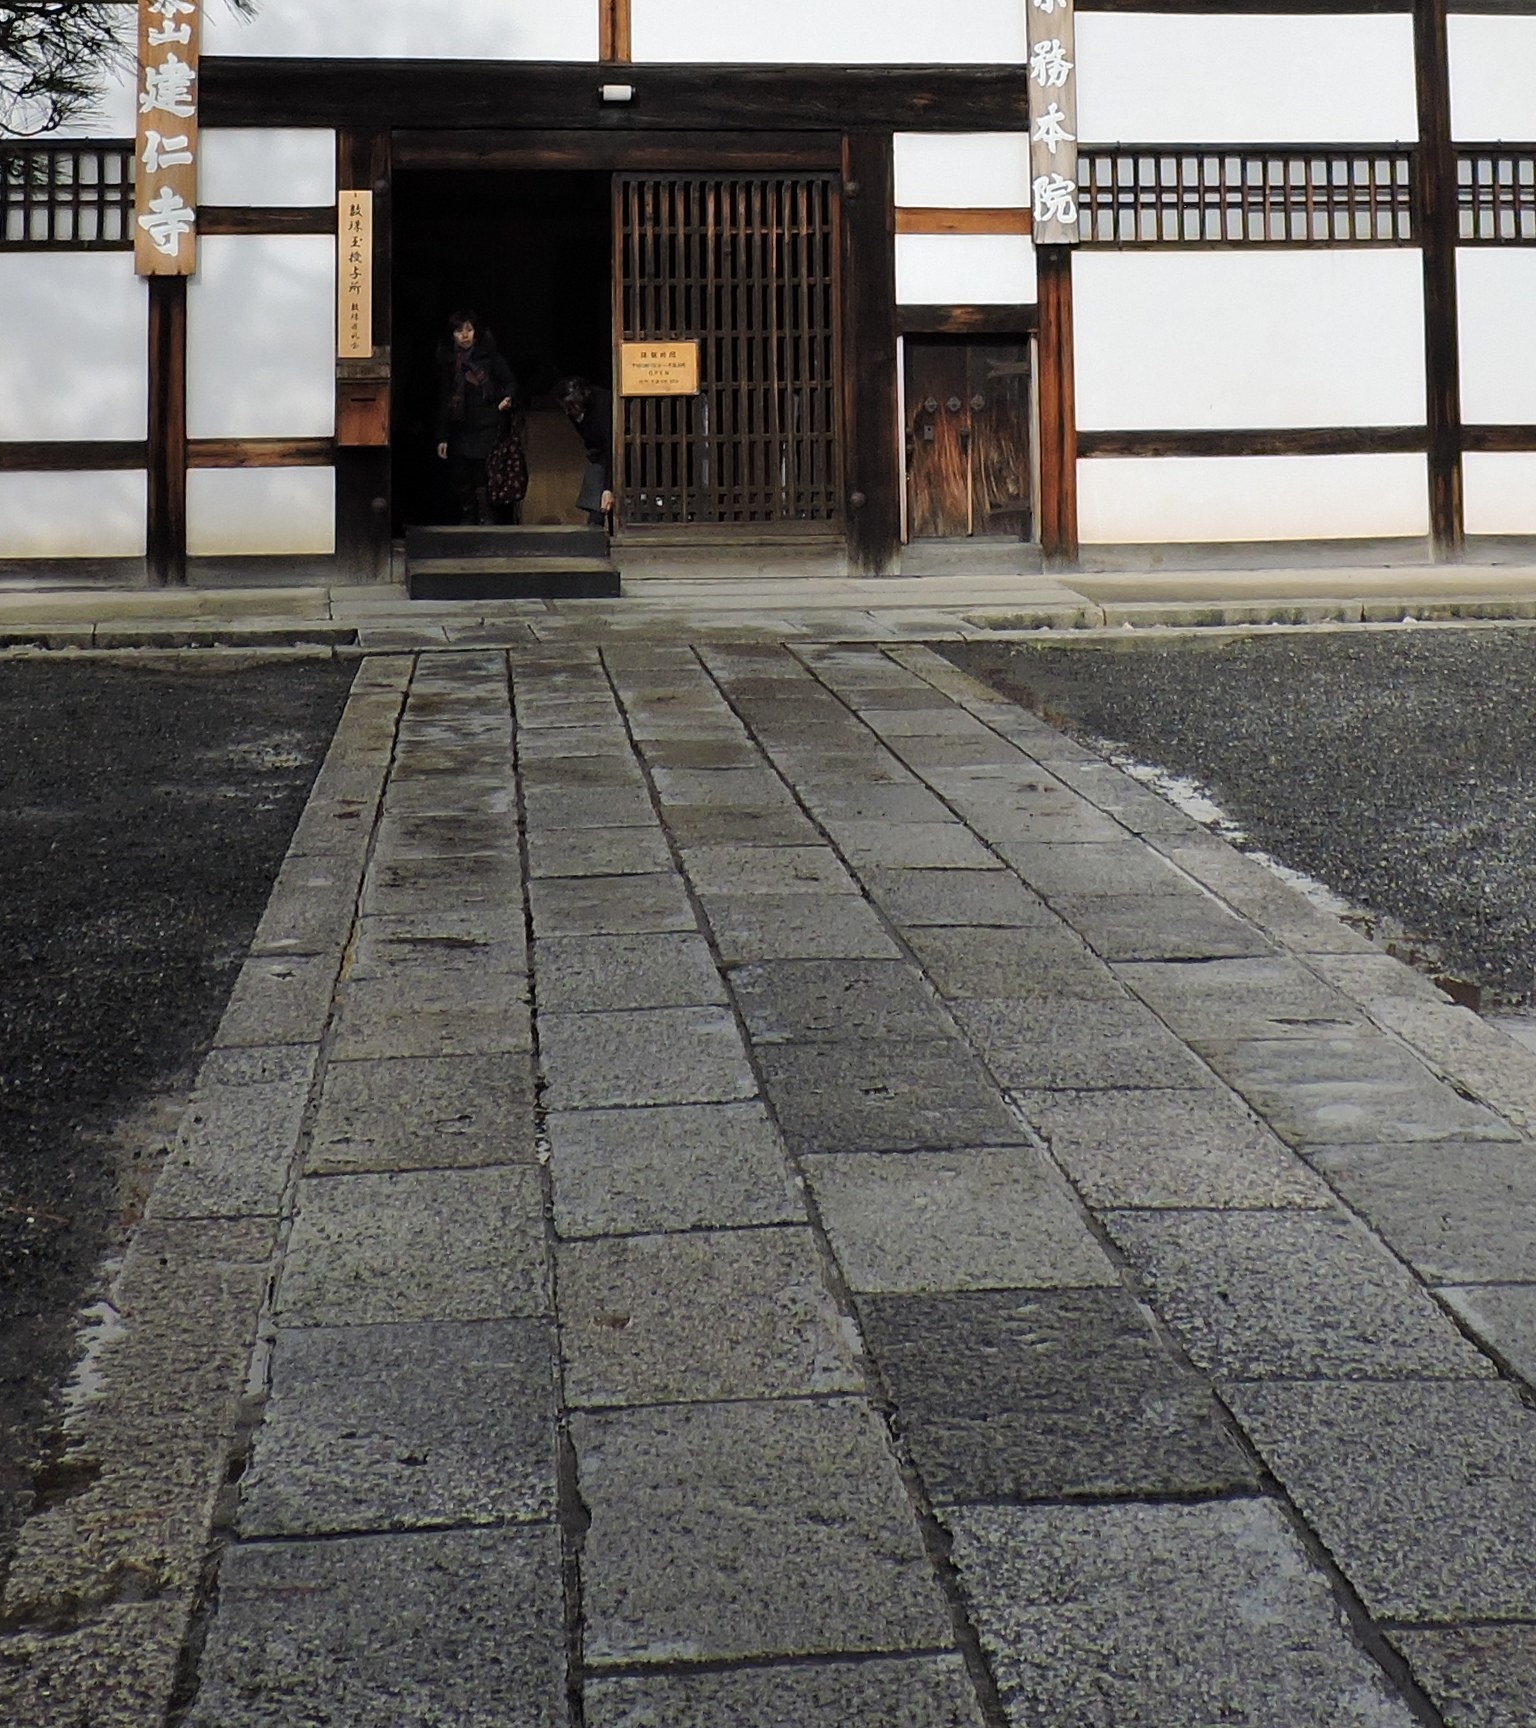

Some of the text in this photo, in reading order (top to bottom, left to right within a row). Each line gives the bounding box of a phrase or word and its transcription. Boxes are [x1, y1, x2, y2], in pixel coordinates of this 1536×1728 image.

[347, 203, 363, 295] 数珠玉授与所
